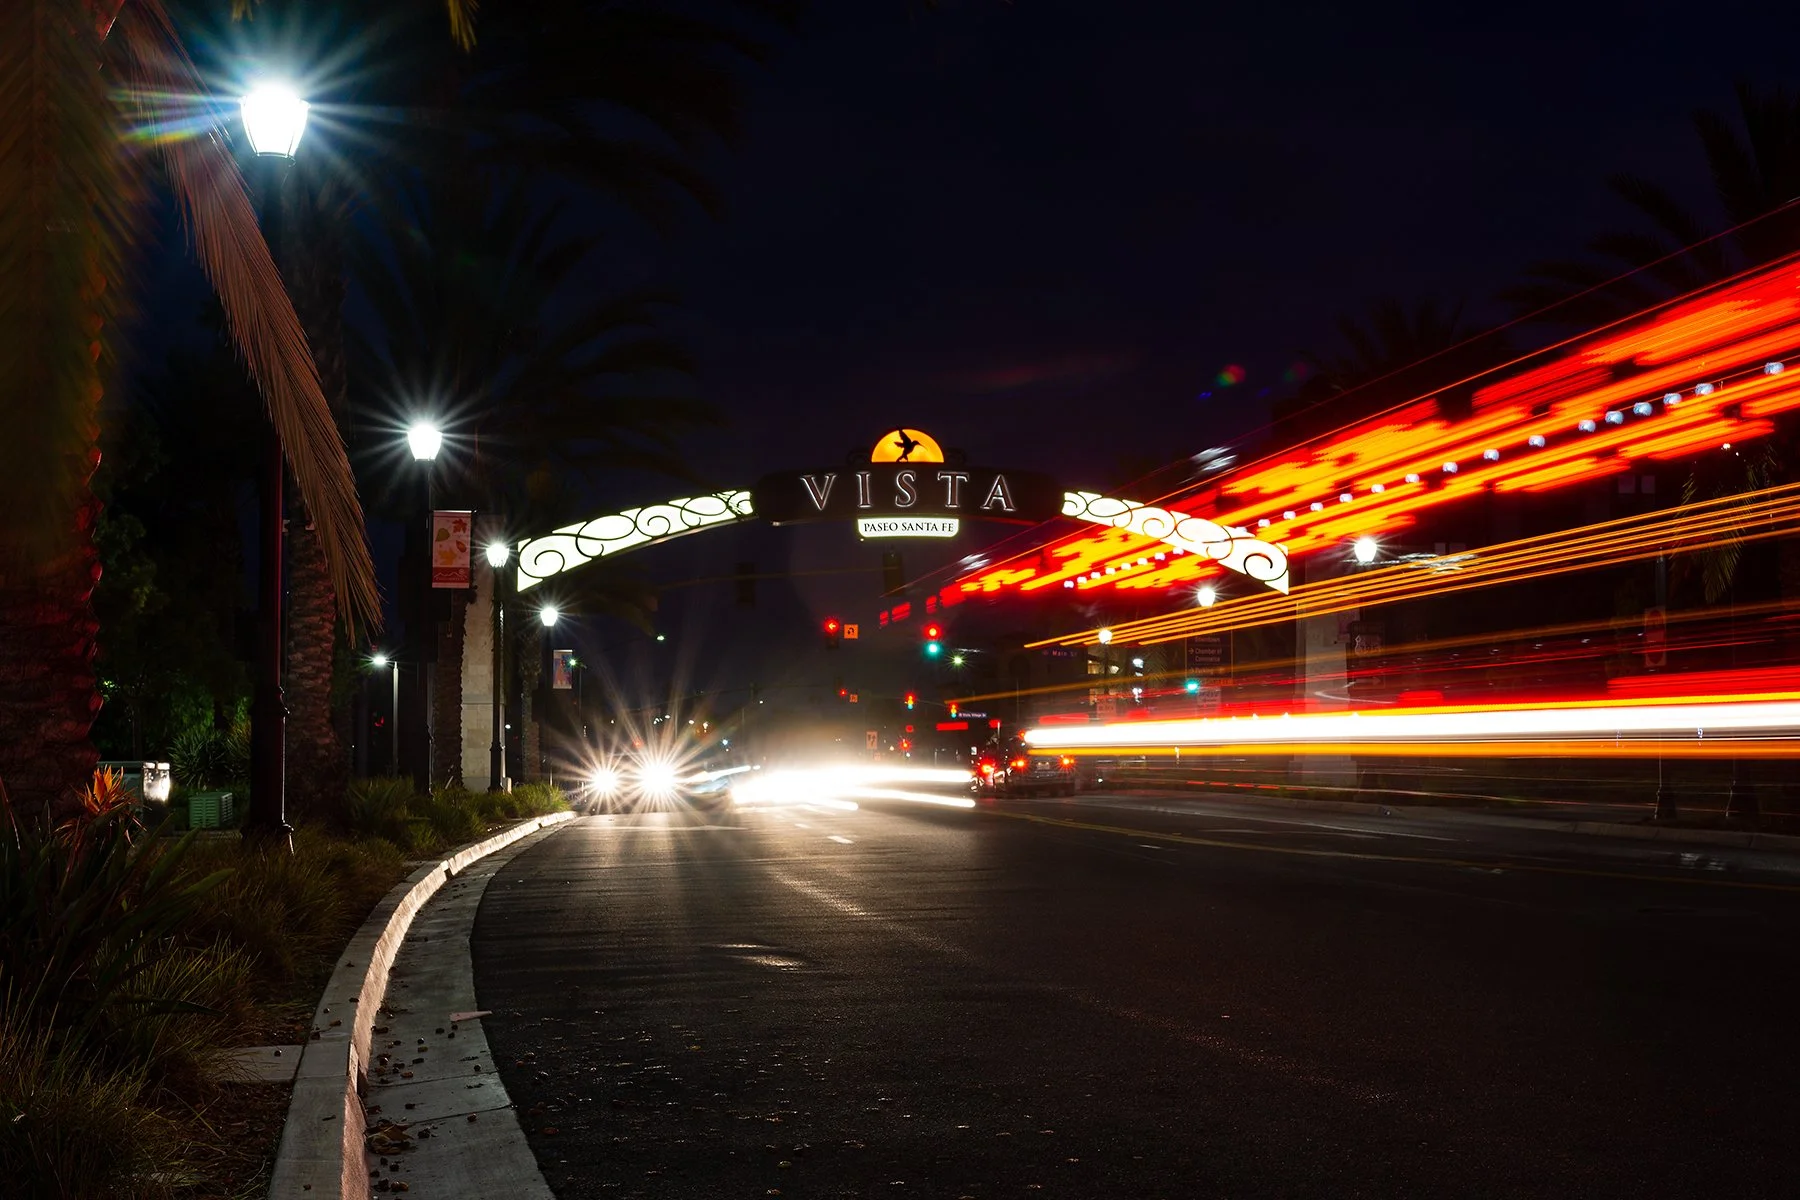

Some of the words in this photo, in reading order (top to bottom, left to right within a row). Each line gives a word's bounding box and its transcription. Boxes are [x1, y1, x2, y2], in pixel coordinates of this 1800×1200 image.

[800, 470, 1017, 511] VISTA
[864, 522, 898, 532] PASEO
[901, 522, 938, 532] SANTA
[941, 522, 954, 532] FE
